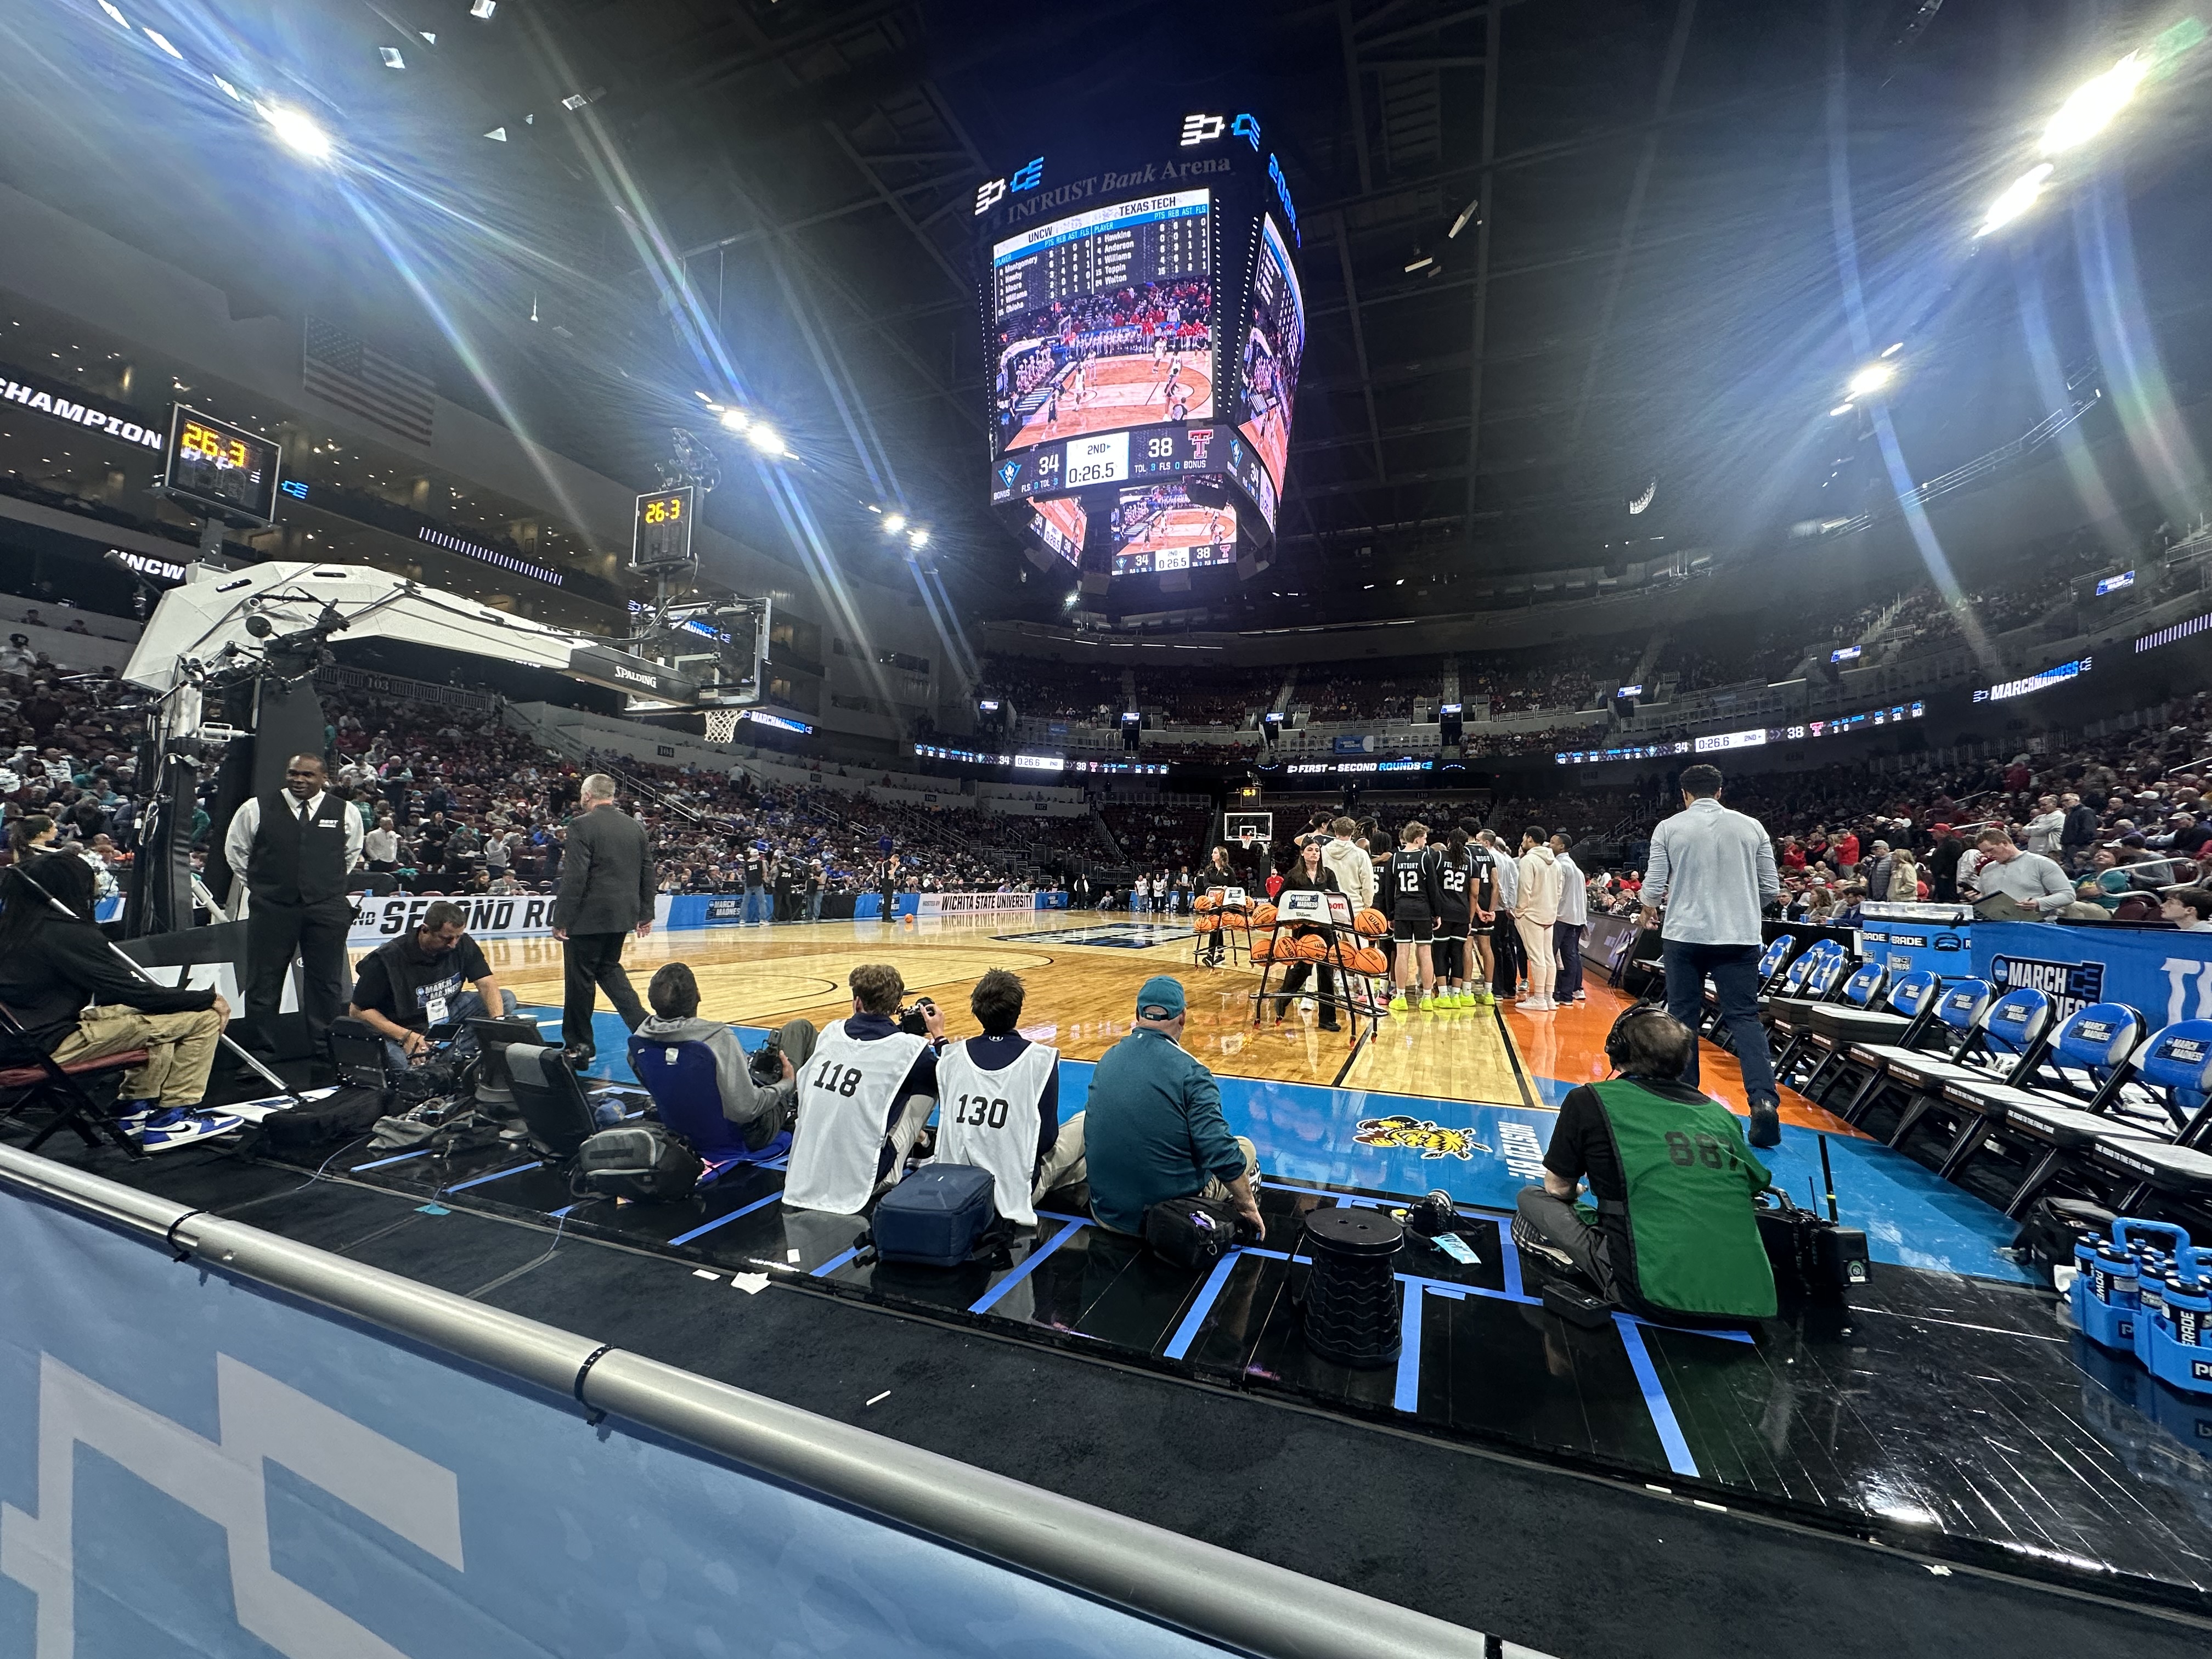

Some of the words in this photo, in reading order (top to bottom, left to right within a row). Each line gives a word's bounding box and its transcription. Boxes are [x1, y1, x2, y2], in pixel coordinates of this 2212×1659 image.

[1007, 176, 1098, 224] INTRUST
[1100, 164, 1156, 193] Bank
[1160, 157, 1231, 180] Arena
[1119, 201, 1149, 216] TEXAS
[1152, 196, 1176, 210] TECH
[1094, 223, 1113, 233] PLAYER
[1182, 207, 1192, 216] AST
[1029, 226, 1052, 243] UNCW
[1104, 230, 1131, 243] Hawkins
[1201, 218, 1206, 226] 0
[1104, 240, 1134, 253] Anderson
[1188, 230, 1192, 238] 1
[1202, 228, 1206, 236] 1
[996, 253, 1012, 266] PLAYER
[1068, 232, 1077, 241] AST
[1188, 241, 1192, 249] 1
[1202, 239, 1206, 247] 1
[1005, 256, 1037, 273] Montgomery
[1105, 263, 1126, 275] Toppin
[1202, 250, 1206, 258] 1
[1087, 281, 1090, 290] 1
[1105, 274, 1127, 285] Walton
[1158, 267, 1165, 275] 15
[182, 423, 246, 467] 26.3
[1087, 443, 1105, 455] 2ND
[1148, 437, 1172, 458] 38
[1039, 454, 1059, 476] 34
[1069, 462, 1114, 483] 0:26.5
[1135, 464, 1146, 473] TOL
[1160, 462, 1171, 471] FLS
[1184, 460, 1206, 469] BONUS
[1250, 462, 1259, 487] 34
[994, 489, 1010, 500] BONUS
[1021, 483, 1030, 493] FLS
[1040, 480, 1050, 488] TOL
[645, 500, 680, 523] 26.3
[1035, 514, 1043, 528] 34
[1064, 539, 1071, 553] 38
[1197, 547, 1210, 559] 38
[1135, 555, 1148, 566] 34
[614, 665, 657, 688] SPALDING
[1674, 742, 1688, 753] 34
[1698, 737, 1729, 750] 0:26.6
[1787, 726, 1804, 739] 38
[1912, 709, 1922, 717] 80
[999, 755, 1009, 765] 34
[1299, 764, 1328, 773] FIRST
[1338, 763, 1377, 772] SECOND
[1379, 761, 1421, 771] ROUNDS
[1398, 871, 1419, 892] 12
[1443, 870, 1465, 892] 22
[1481, 864, 1489, 883] 4
[714, 900, 735, 909] MARCH
[715, 907, 740, 916] MADNES
[941, 896, 974, 911] WICHITA
[975, 895, 996, 910] STATE
[996, 894, 1033, 909] UNIVERSITY
[380, 900, 515, 934] SEND
[425, 979, 452, 994] MARCH
[2008, 961, 2067, 994] MARCH
[2171, 1039, 2199, 1051] MARCH
[813, 1060, 862, 1098] 118
[956, 1093, 1009, 1130] 130
[1498, 1121, 1544, 1161] HOSTED
[1505, 1159, 1548, 1180] BY:
